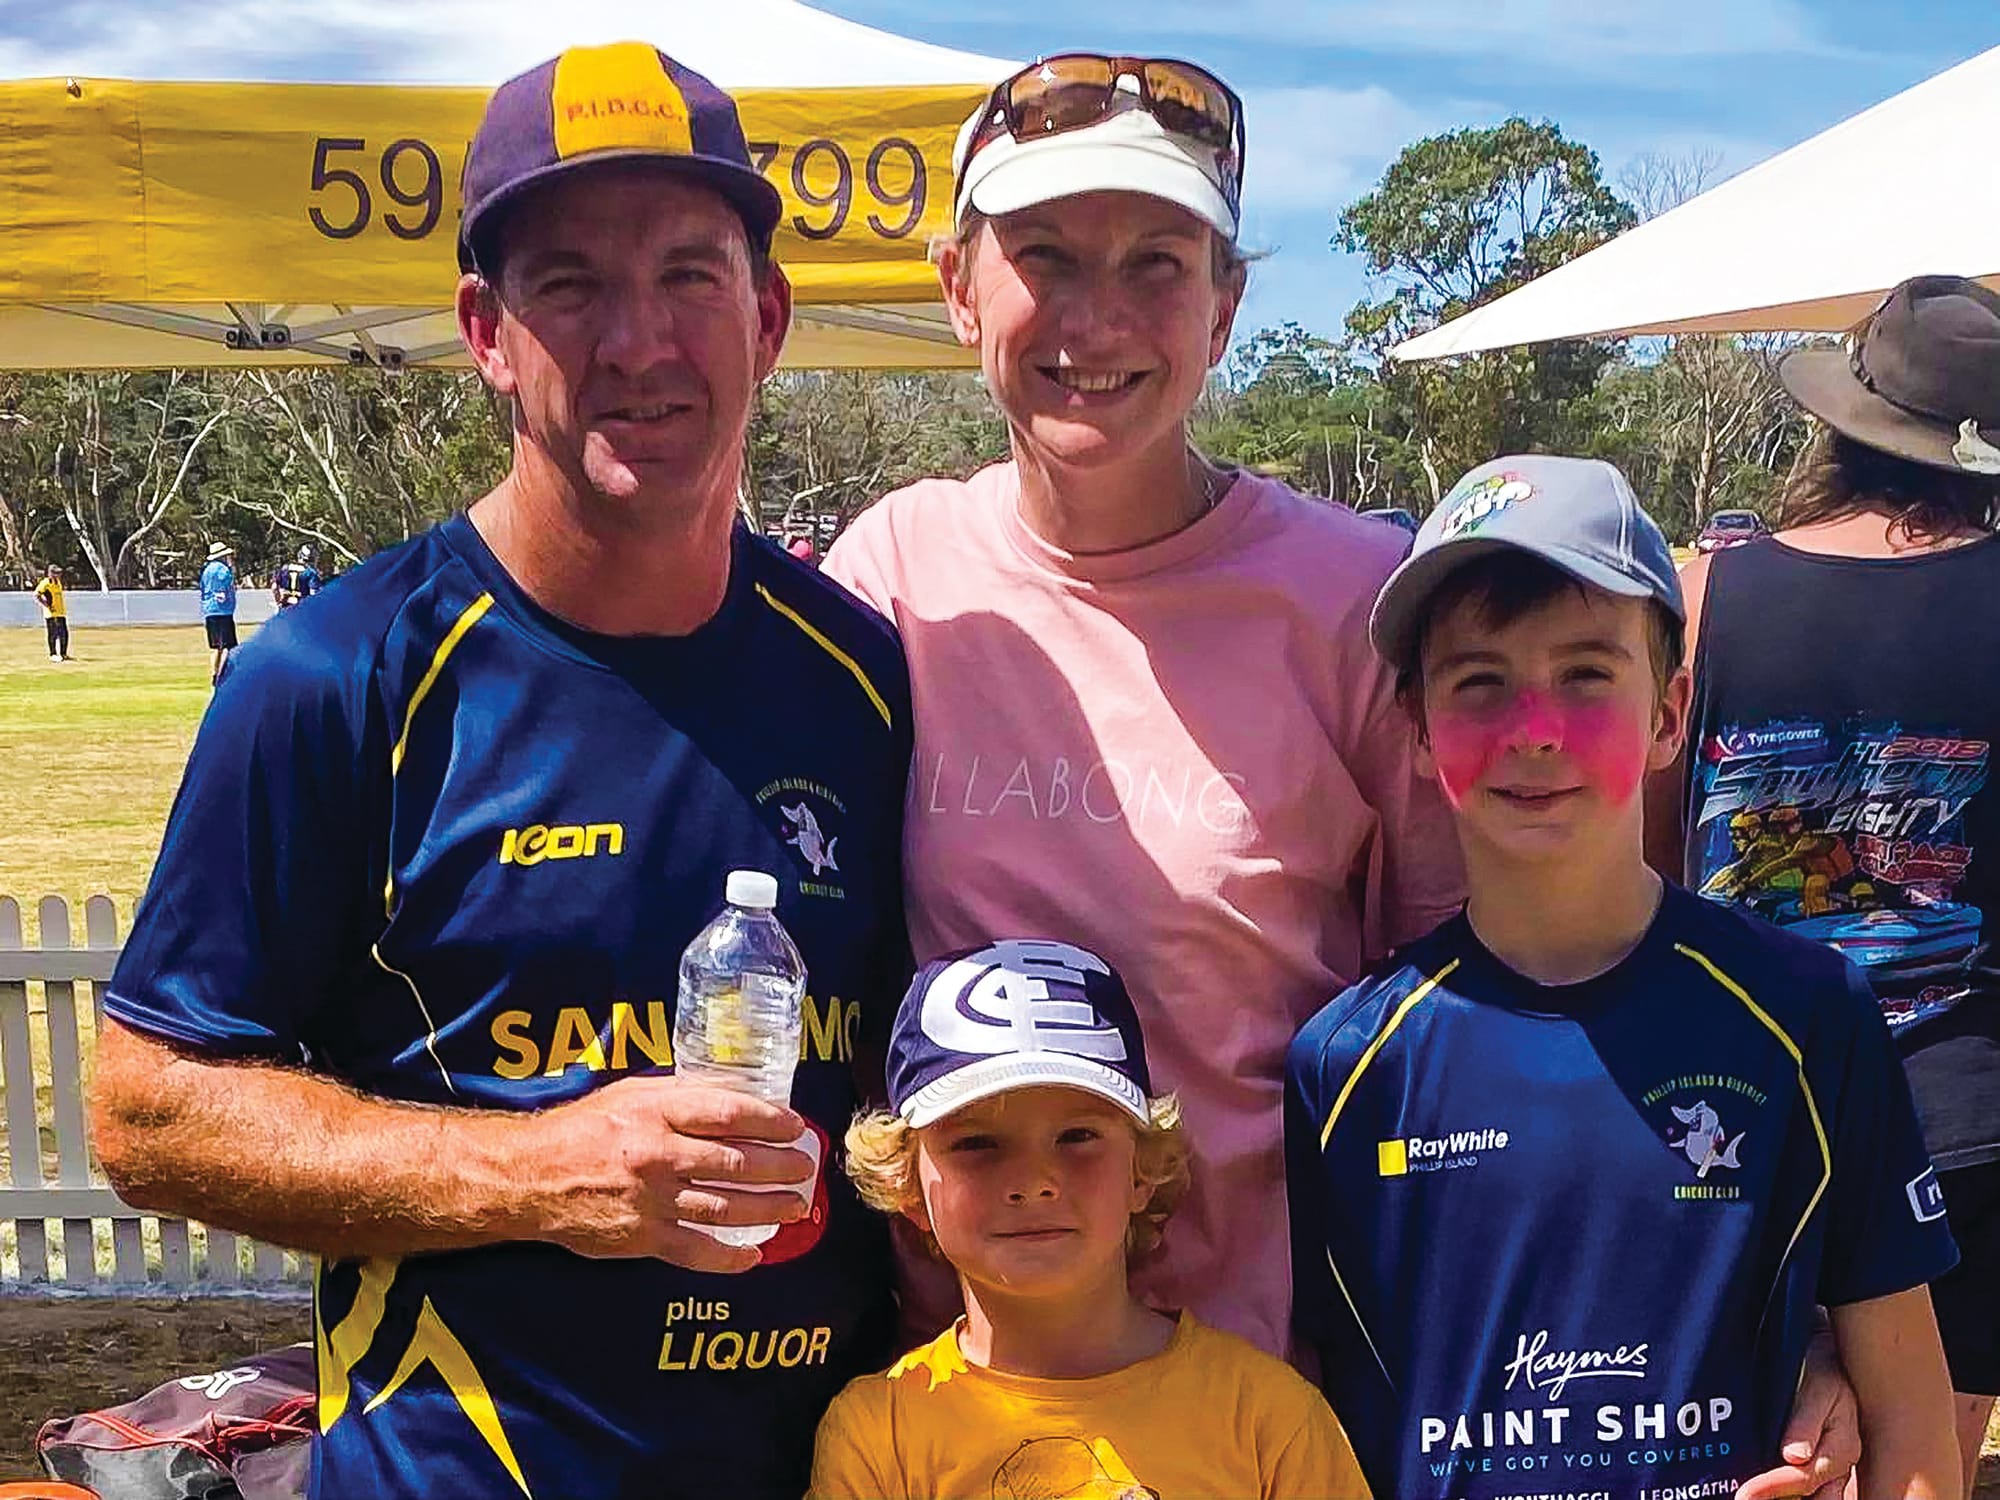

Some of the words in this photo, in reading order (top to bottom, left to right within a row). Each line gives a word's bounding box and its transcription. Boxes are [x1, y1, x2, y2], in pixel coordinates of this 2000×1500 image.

[308, 137, 467, 240] 59
[1824, 797, 1972, 838] EIGHTY
[665, 1295, 731, 1328] plus
[657, 1326, 833, 1371] LIQUOR
[1503, 1329, 1650, 1402] Haymes
[1419, 1406, 1570, 1453] PAINT
[1596, 1396, 1734, 1442] SHOP
[1505, 1454, 1550, 1472] GOT
[1563, 1452, 1612, 1468] YOU
[1627, 1442, 1732, 1466] COVERED
[1639, 1478, 1740, 1500] LEONGATHA
